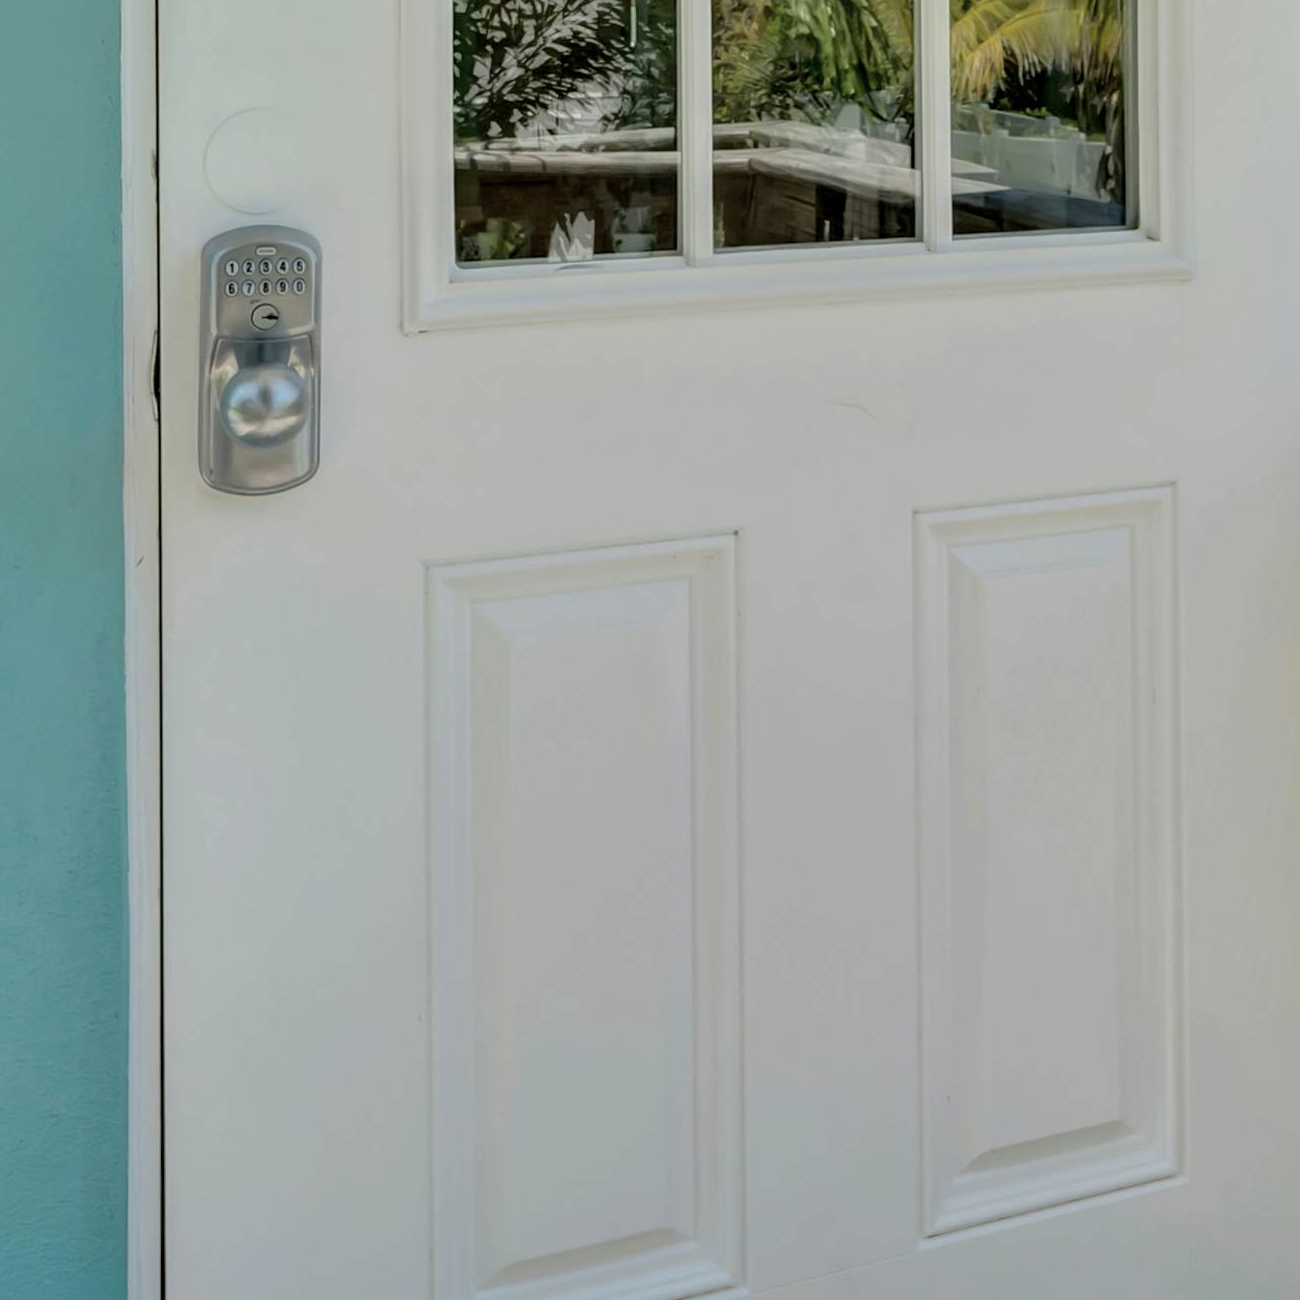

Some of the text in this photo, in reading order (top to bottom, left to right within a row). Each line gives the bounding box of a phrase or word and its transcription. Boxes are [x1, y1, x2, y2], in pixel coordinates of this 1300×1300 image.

[246, 262, 252, 273] 2
[263, 261, 269, 273] 3
[280, 261, 286, 272] 4
[297, 261, 303, 272] 5
[229, 281, 303, 294] 6 7 8 9 0
